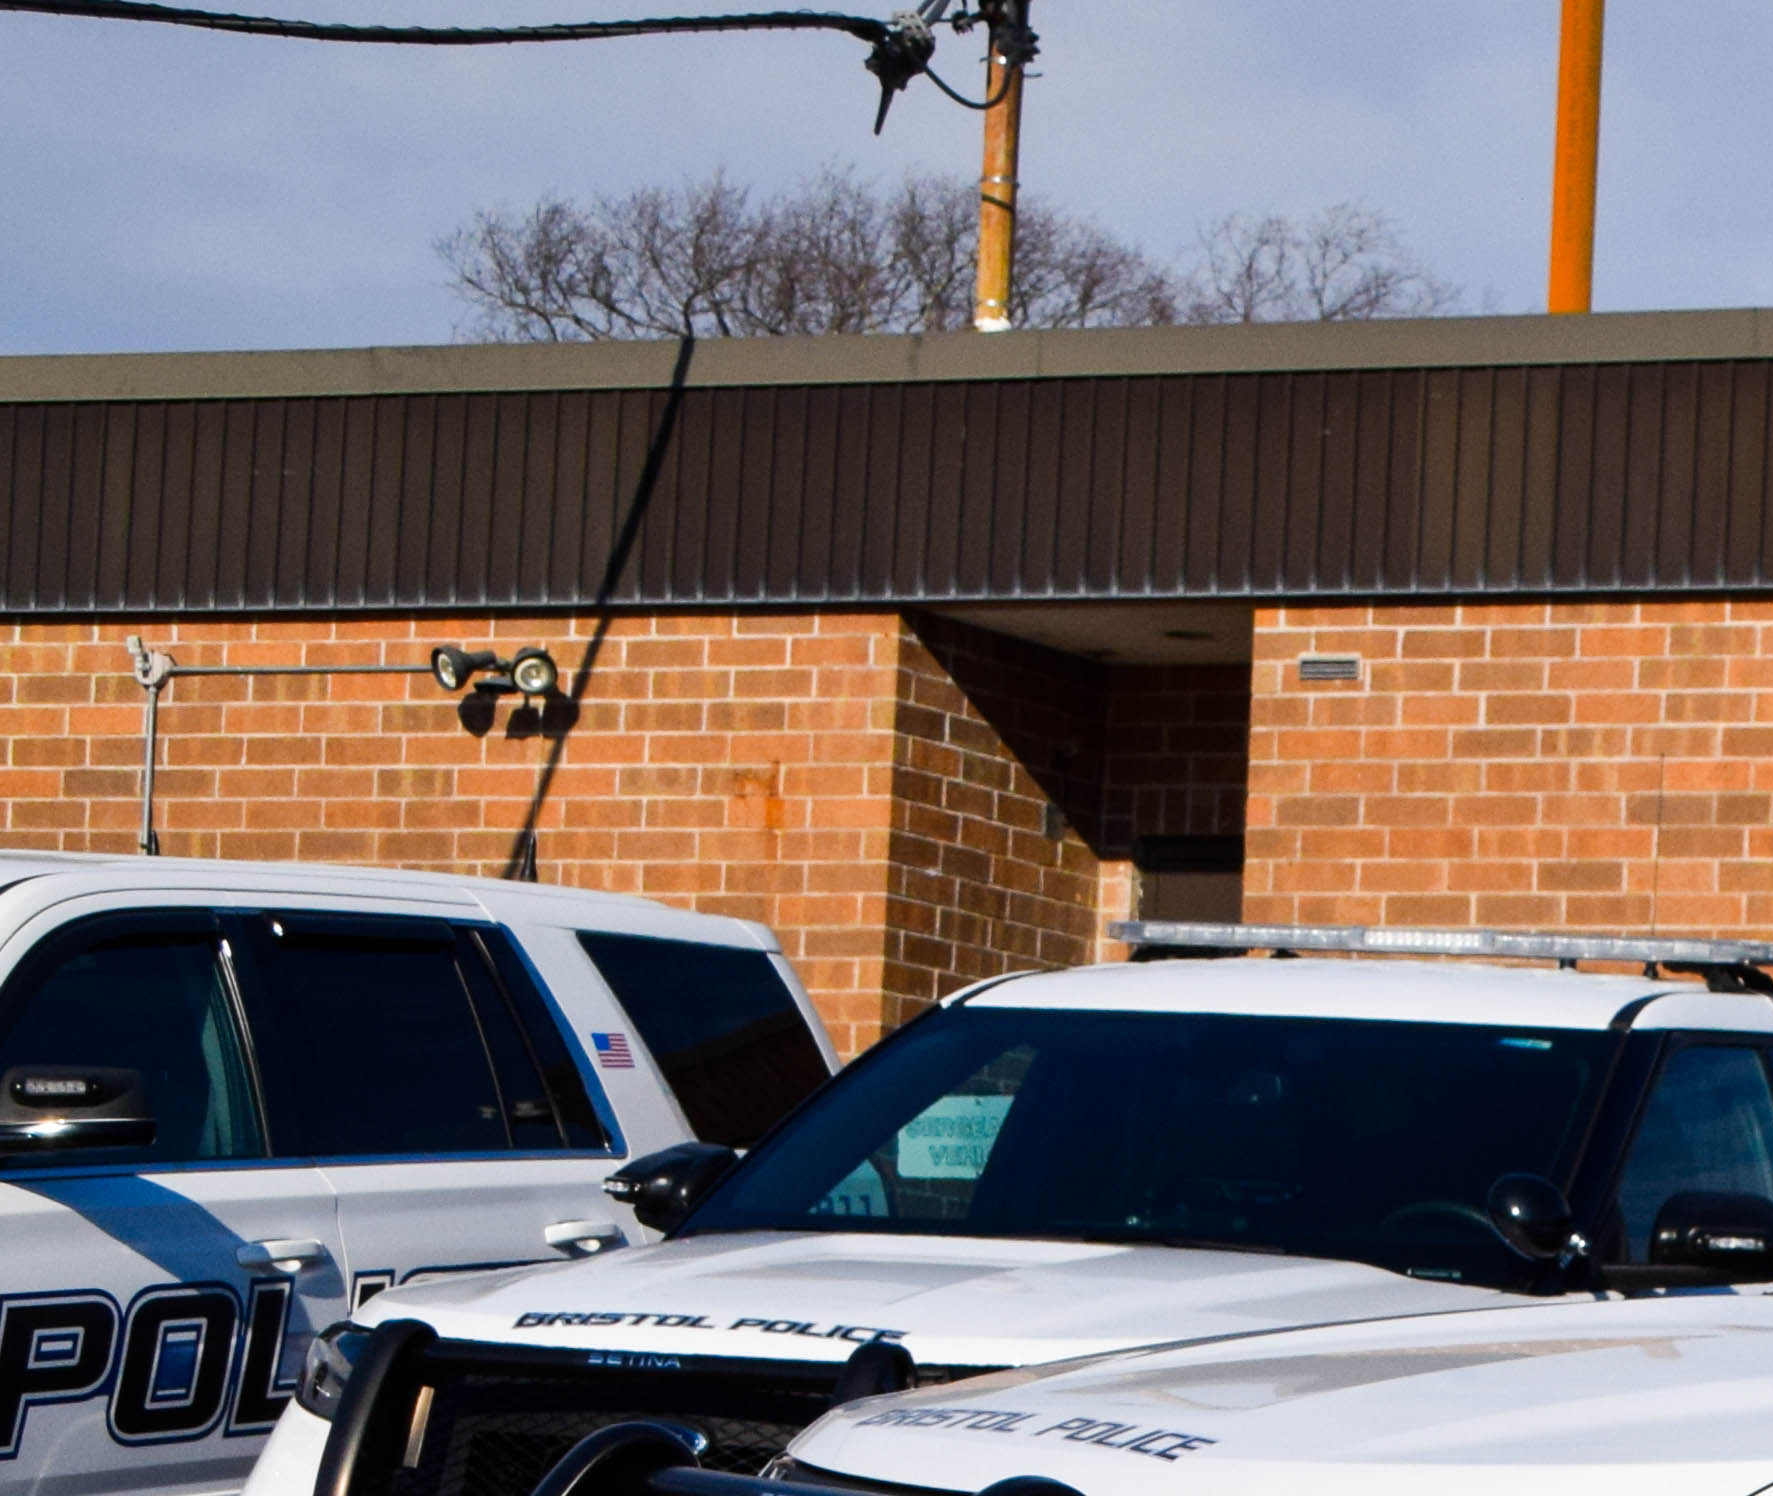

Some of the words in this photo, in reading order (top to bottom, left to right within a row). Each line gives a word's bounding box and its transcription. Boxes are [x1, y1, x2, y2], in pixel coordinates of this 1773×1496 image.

[512, 1311, 717, 1330] BRISTOL
[728, 1317, 912, 1343] POLICE
[587, 1351, 682, 1369] SETINA
[855, 1407, 1037, 1433] BRISTOL
[1034, 1416, 1221, 1462] POLICE
